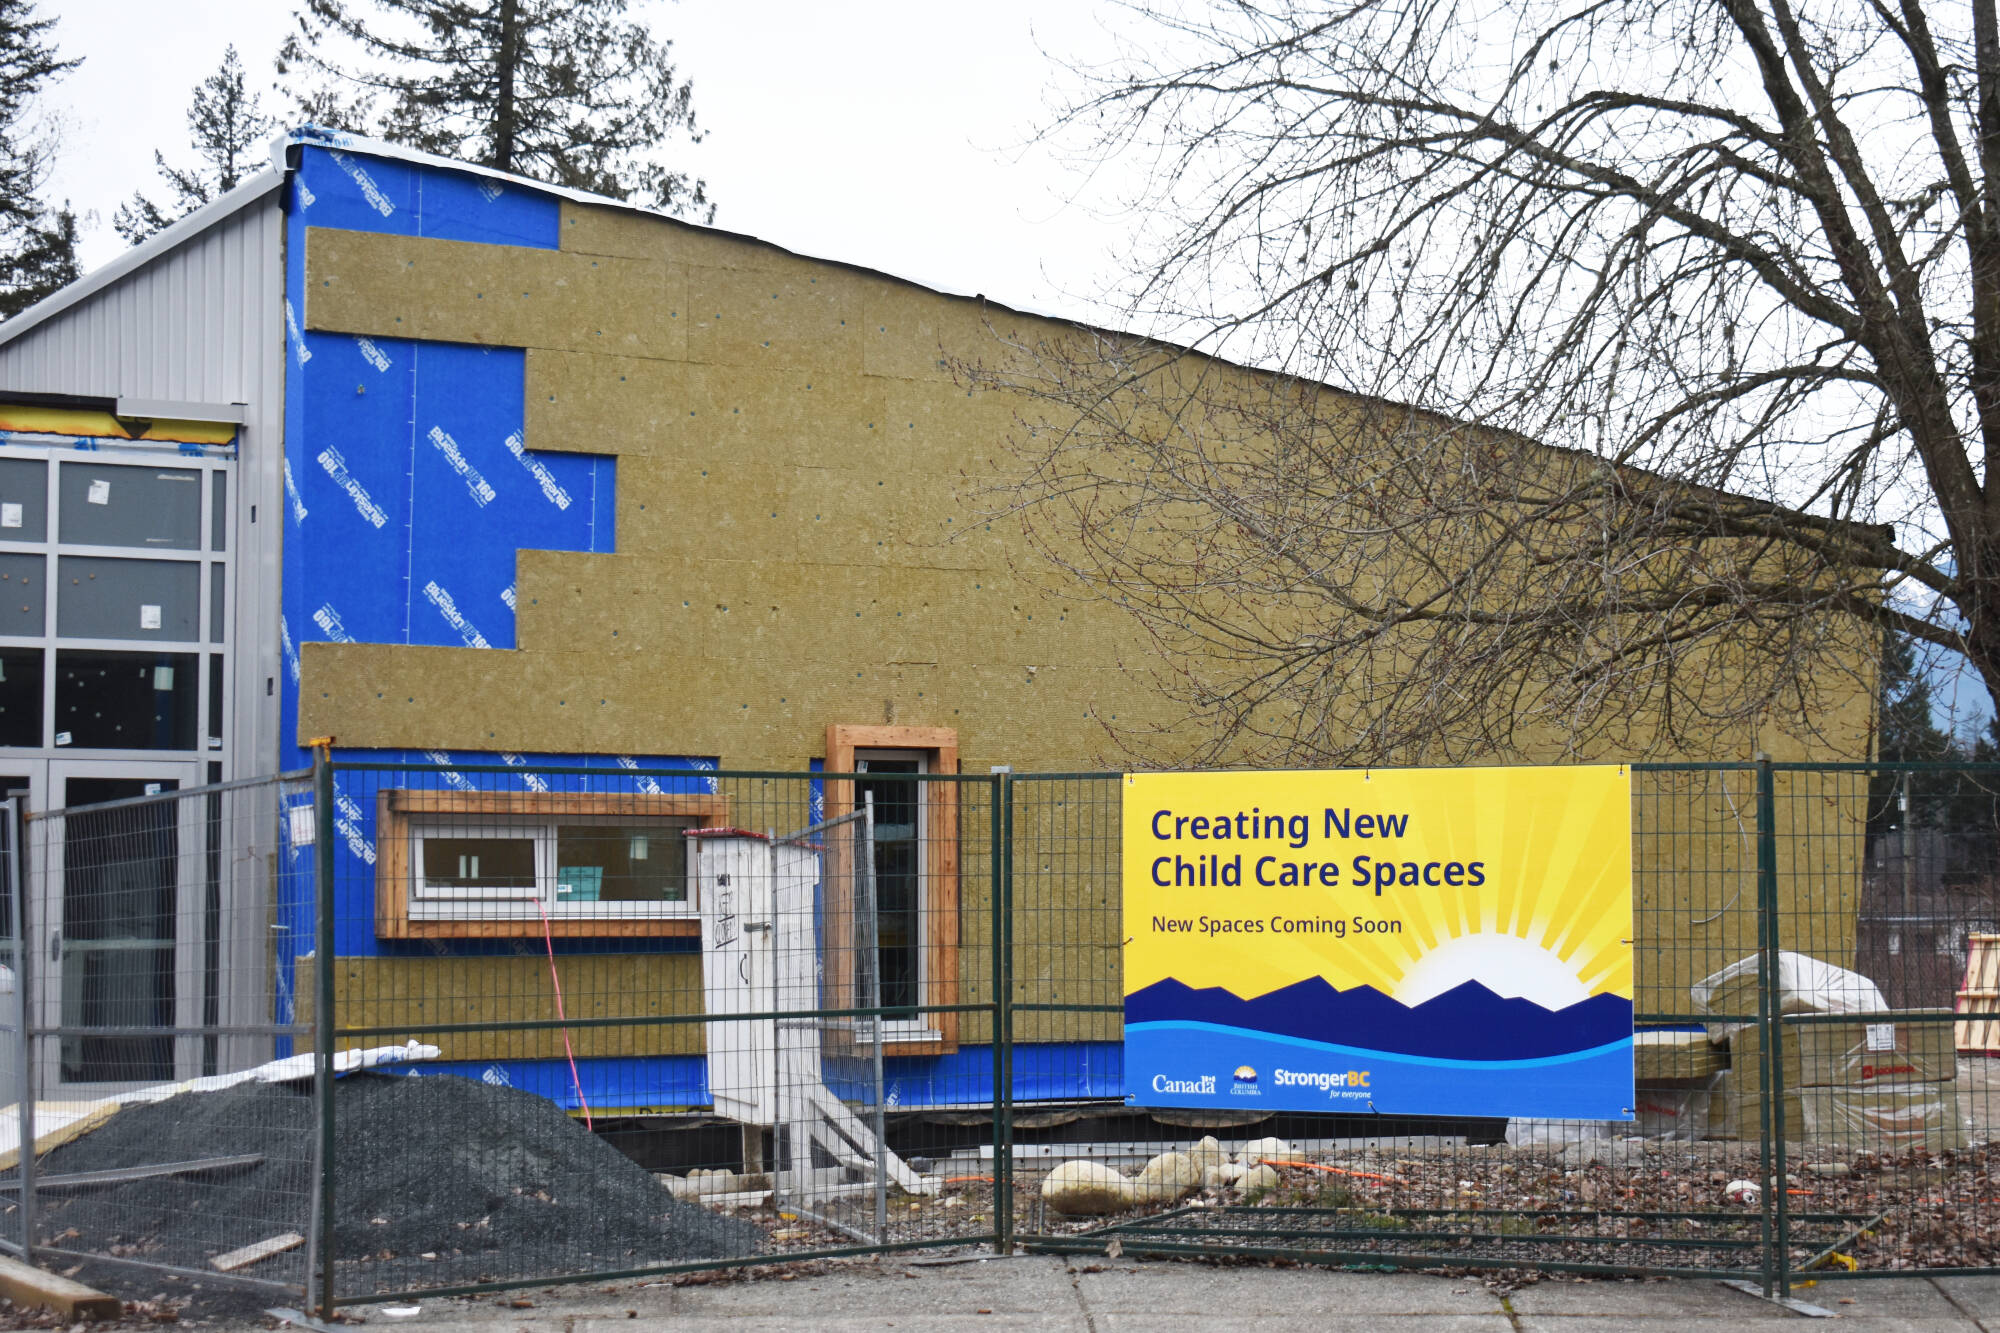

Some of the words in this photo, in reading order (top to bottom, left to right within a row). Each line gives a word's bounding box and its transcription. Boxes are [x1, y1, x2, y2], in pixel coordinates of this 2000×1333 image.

[1152, 808, 1309, 848] Creating
[1324, 808, 1409, 839] New
[1151, 854, 1241, 887] Child
[1255, 855, 1340, 887] Care
[1352, 855, 1486, 897] Spaces
[1152, 916, 1194, 933] New
[1199, 915, 1265, 938] Spaces
[1270, 915, 1346, 939] Coming
[1352, 916, 1402, 934] Soon
[1152, 1074, 1216, 1094] Canada
[1274, 1068, 1371, 1091] StrongerBC
[1330, 1089, 1341, 1099] for
[1341, 1091, 1371, 1100] everyone
